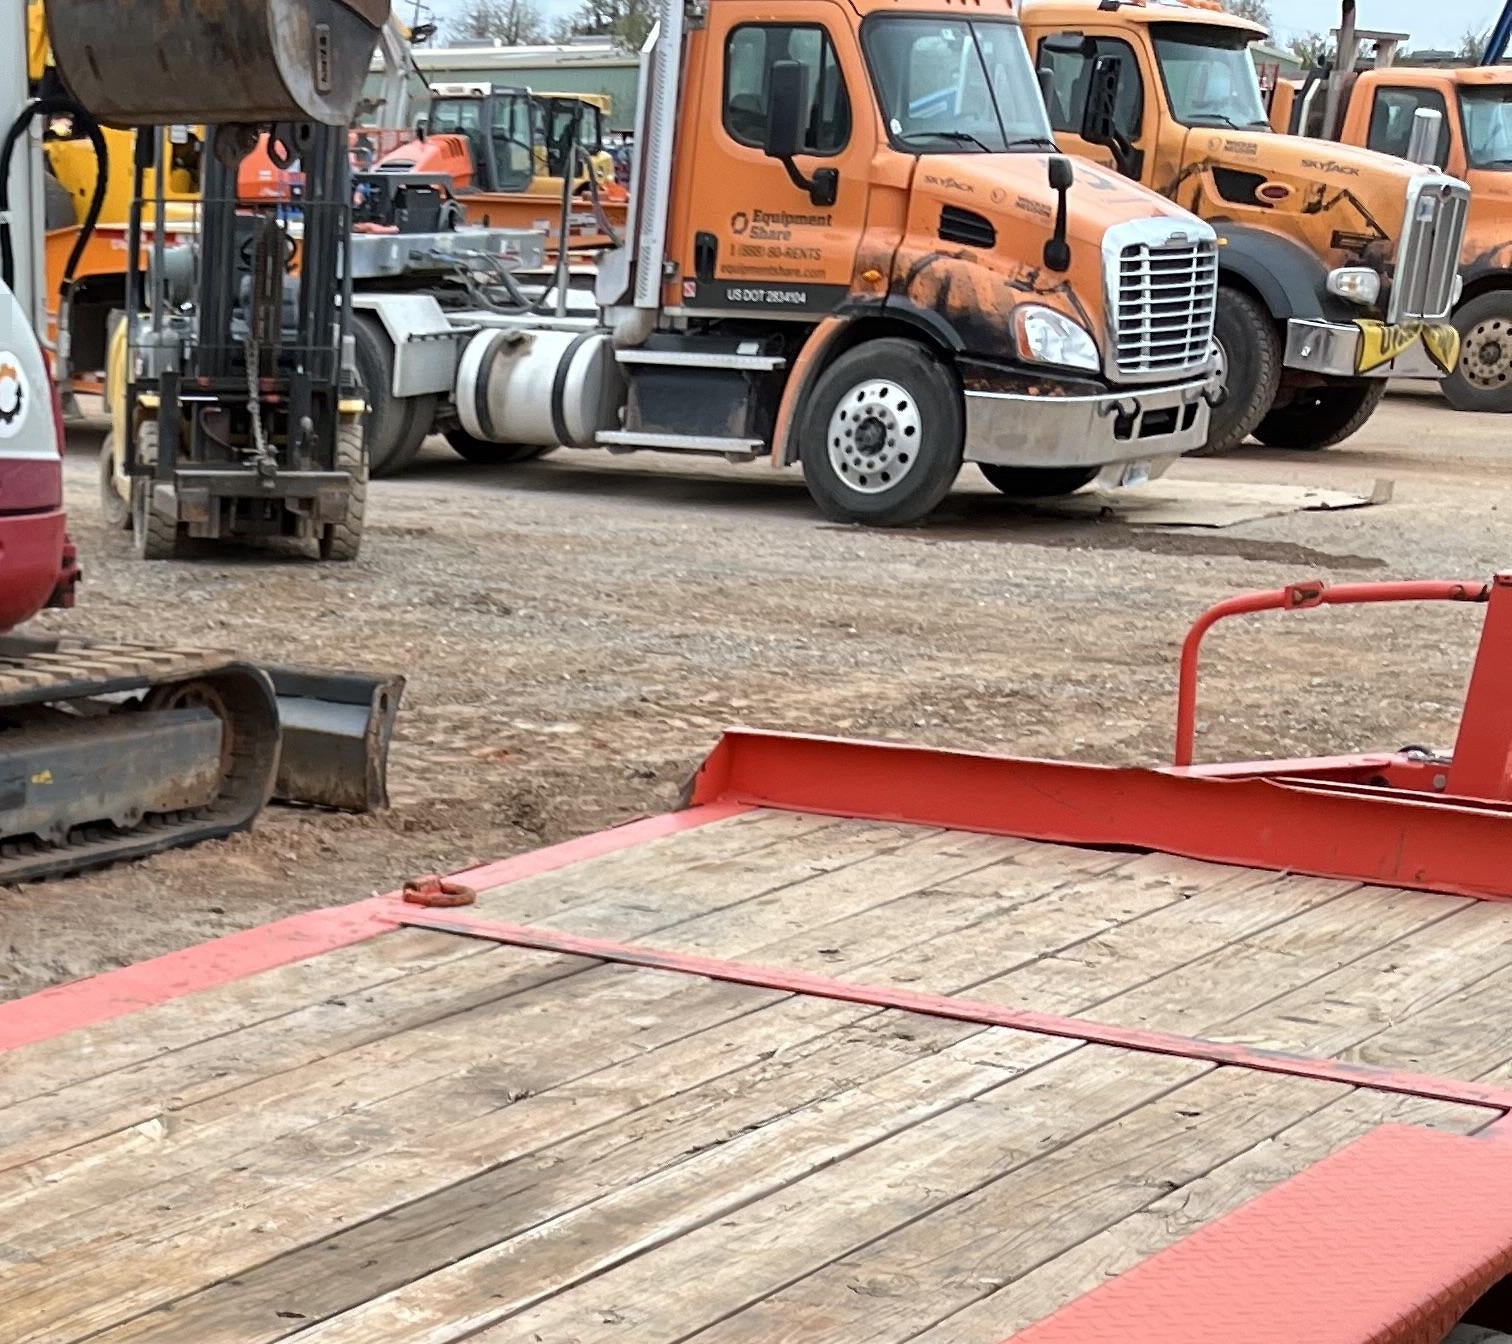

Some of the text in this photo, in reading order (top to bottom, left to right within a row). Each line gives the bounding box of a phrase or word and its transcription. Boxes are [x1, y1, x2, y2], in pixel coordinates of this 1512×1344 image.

[752, 209, 832, 227] Equipment
[749, 226, 792, 241] Share
[727, 288, 742, 302] US
[743, 289, 766, 303] DOT
